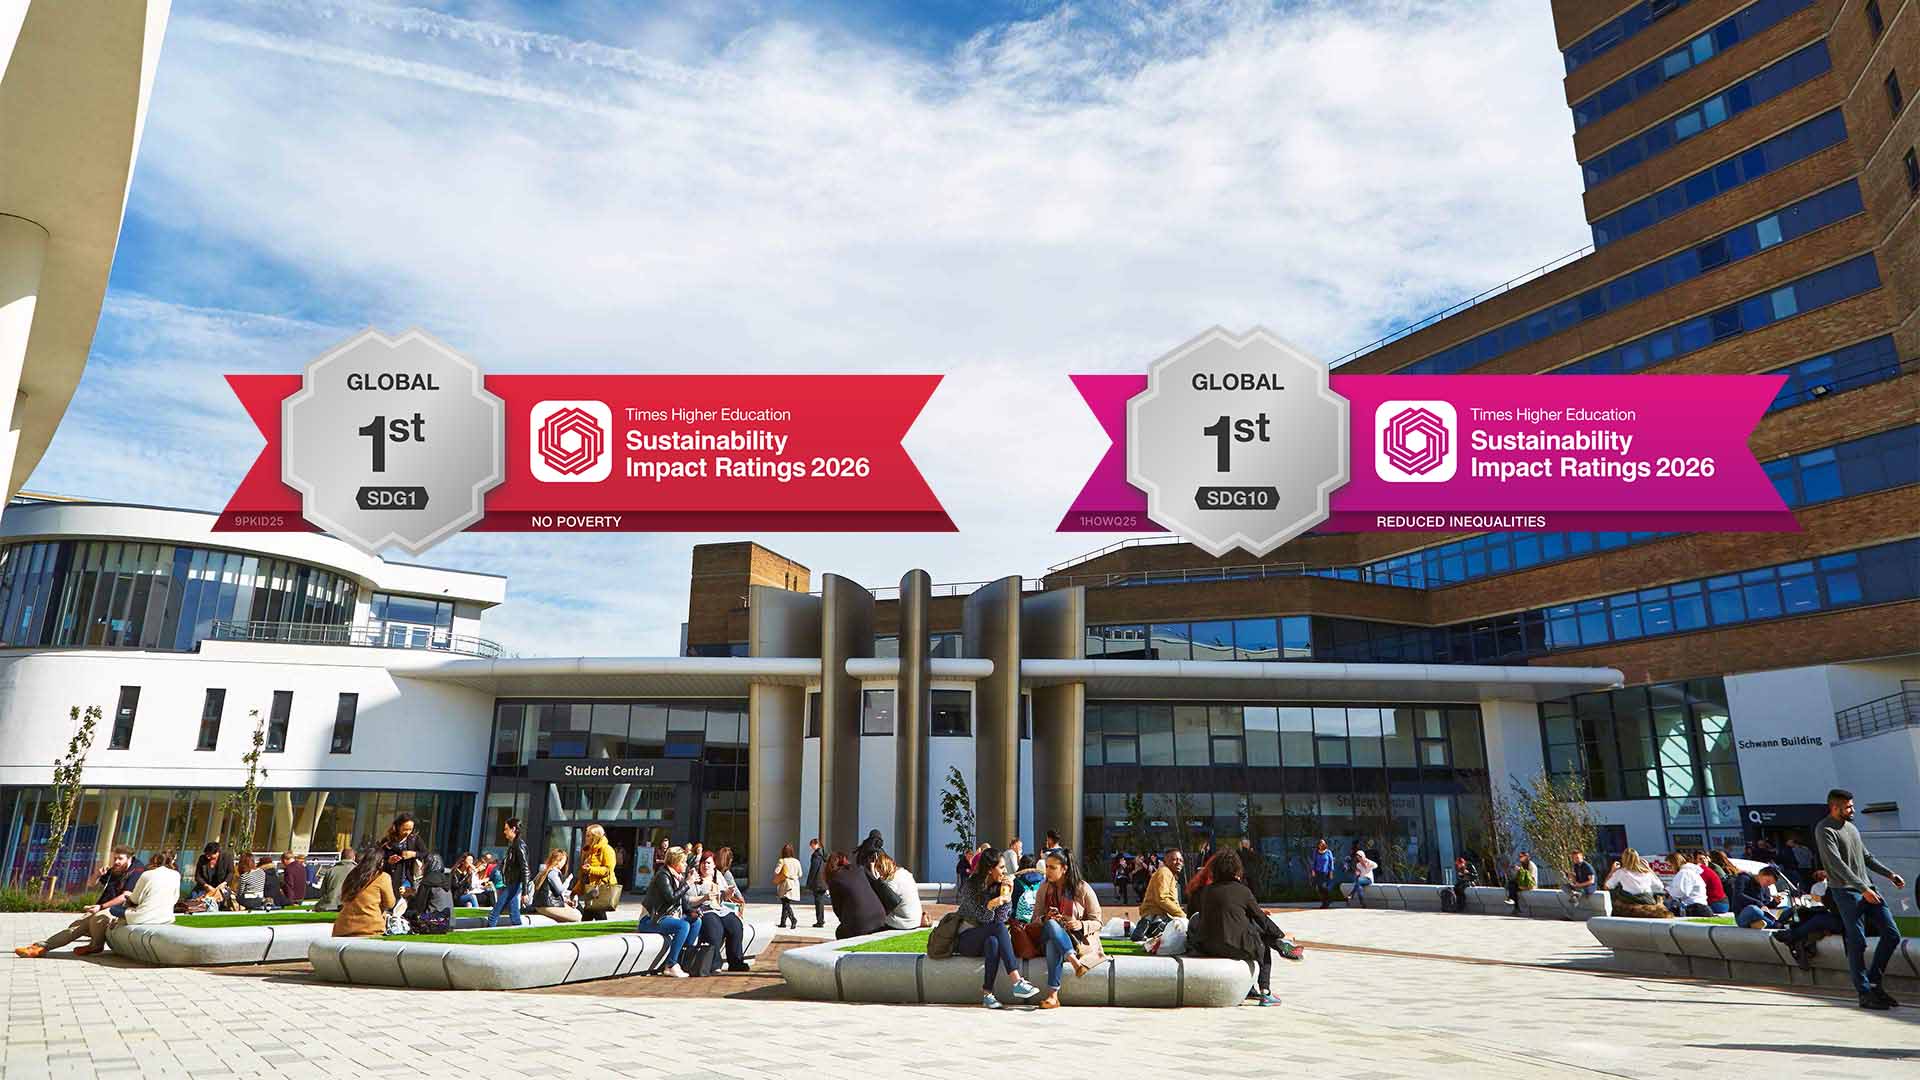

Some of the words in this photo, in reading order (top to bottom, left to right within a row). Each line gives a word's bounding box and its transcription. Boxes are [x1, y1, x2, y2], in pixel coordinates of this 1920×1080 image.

[1738, 740, 1779, 749] Schwann
[1781, 736, 1823, 746] Building
[564, 765, 609, 776] Student
[612, 765, 654, 776] Central
